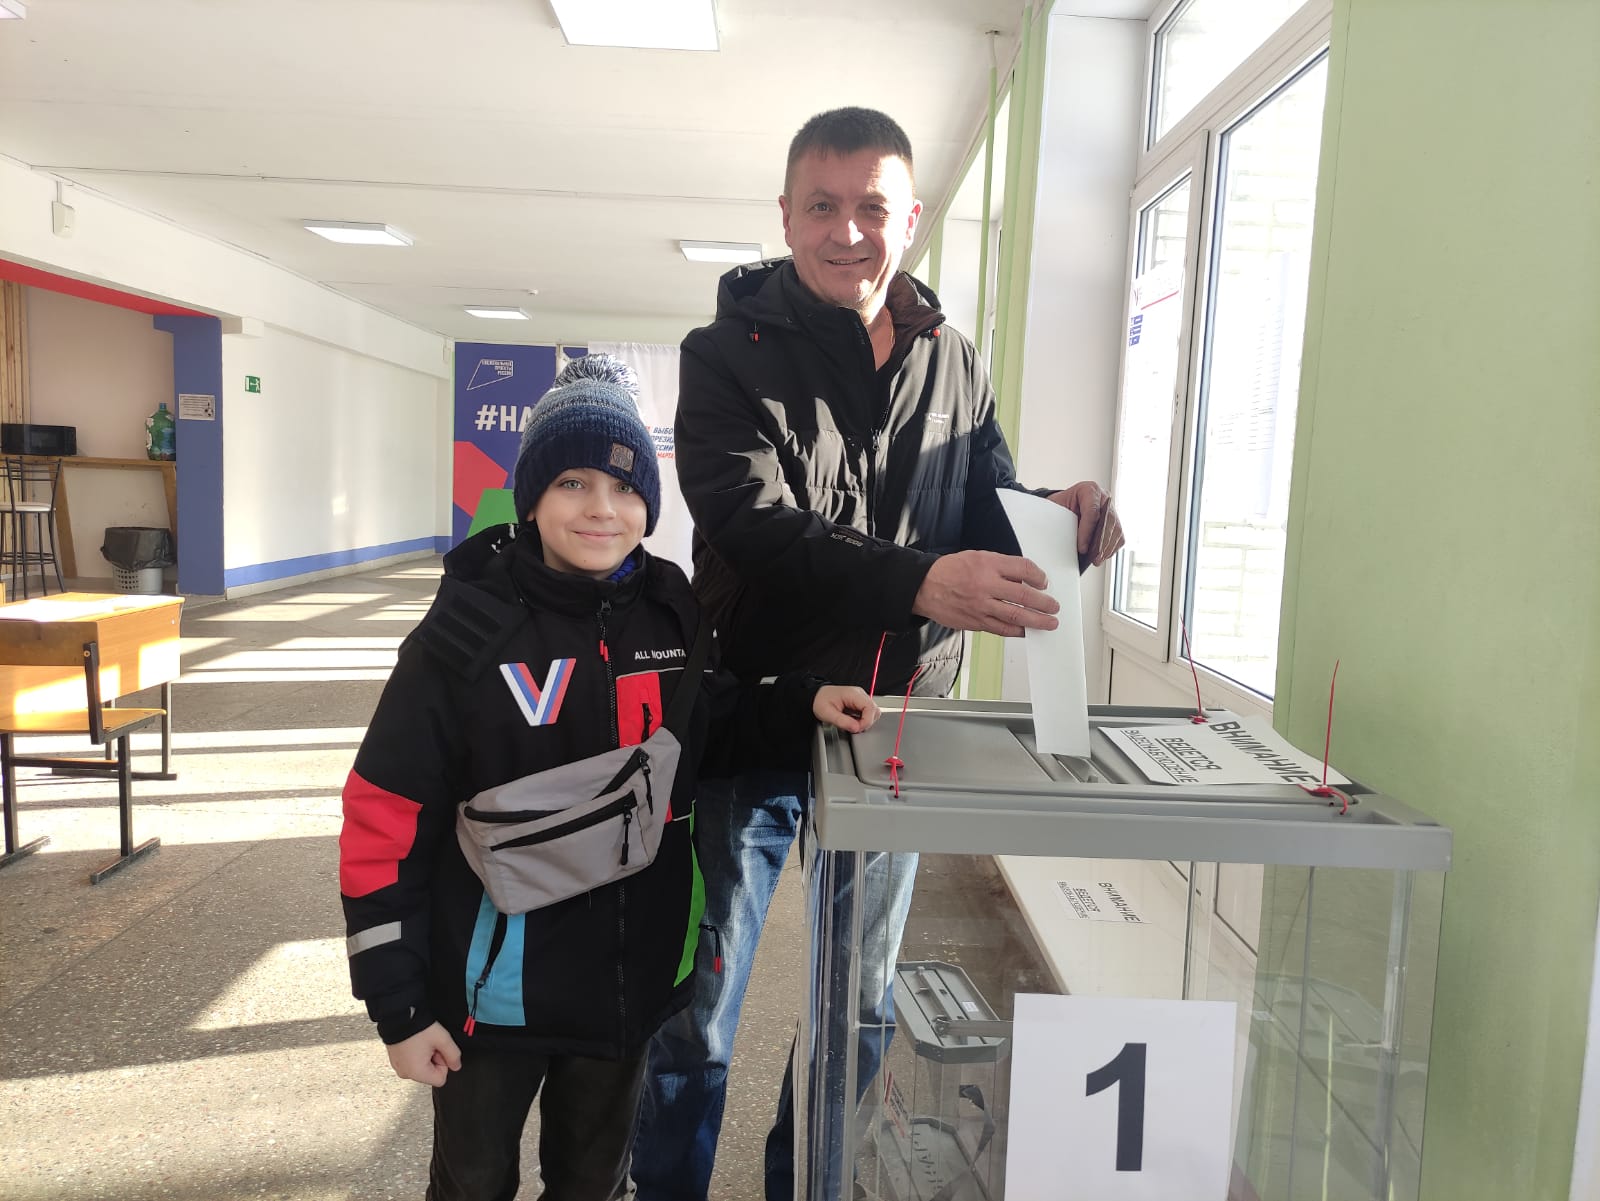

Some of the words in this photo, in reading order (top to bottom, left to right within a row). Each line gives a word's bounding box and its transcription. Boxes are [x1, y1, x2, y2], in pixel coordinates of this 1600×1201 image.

[634, 651, 650, 660] ALL
[498, 657, 577, 727] V
[1161, 737, 1223, 771] ВЕДЕТСЯ
[1209, 721, 1322, 783] ВНИМАНИЕ
[1098, 882, 1141, 922] ВНИМАНИЕ
[1085, 1042, 1147, 1172] 1
